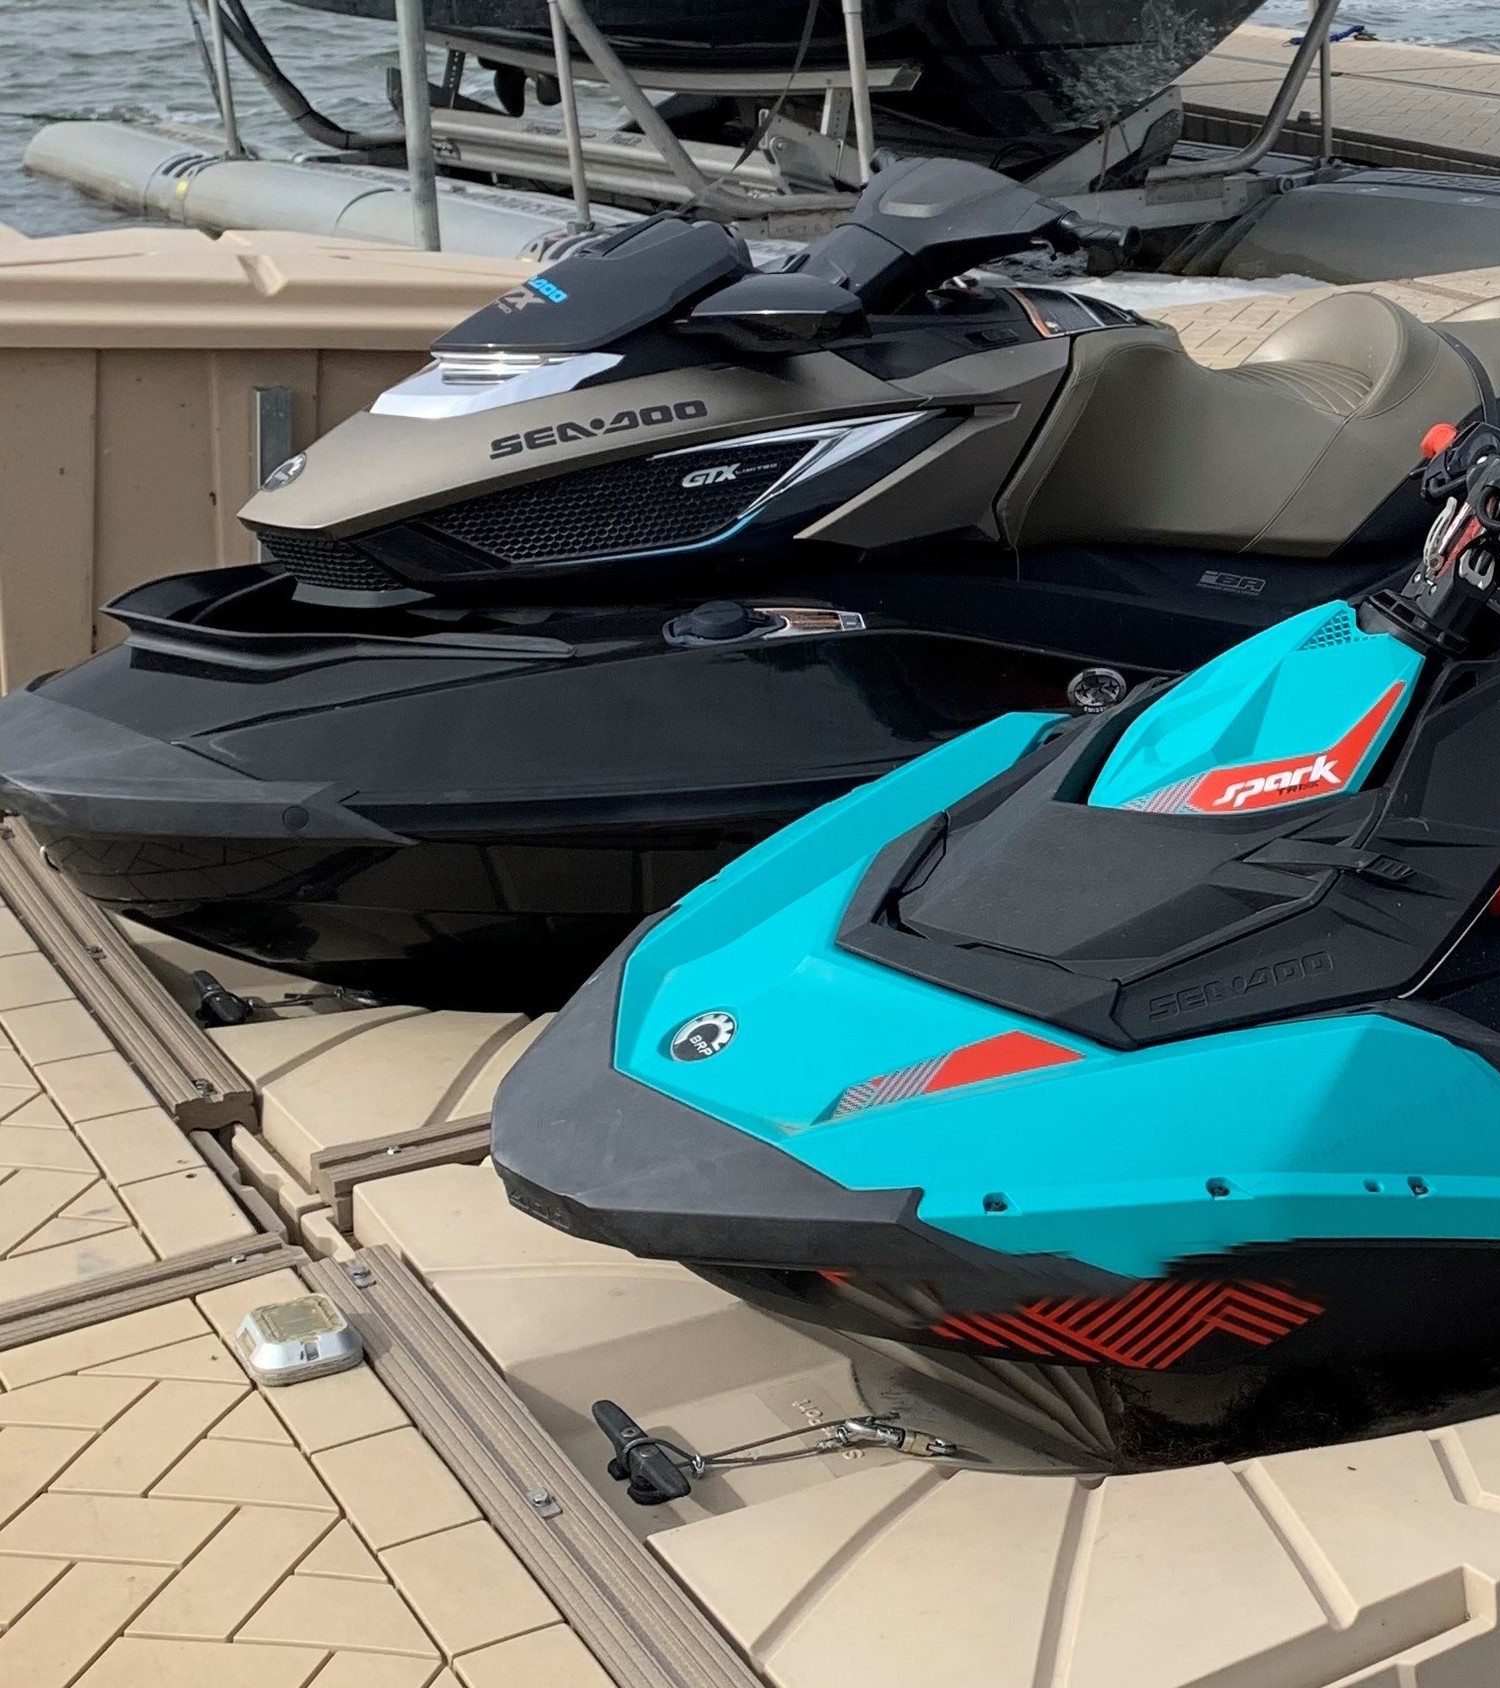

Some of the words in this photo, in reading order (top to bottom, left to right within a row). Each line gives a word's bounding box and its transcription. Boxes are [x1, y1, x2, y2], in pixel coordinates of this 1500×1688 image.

[682, 463, 741, 488] GTX
[1212, 755, 1332, 808] spark
[689, 1034, 713, 1056] BRP
